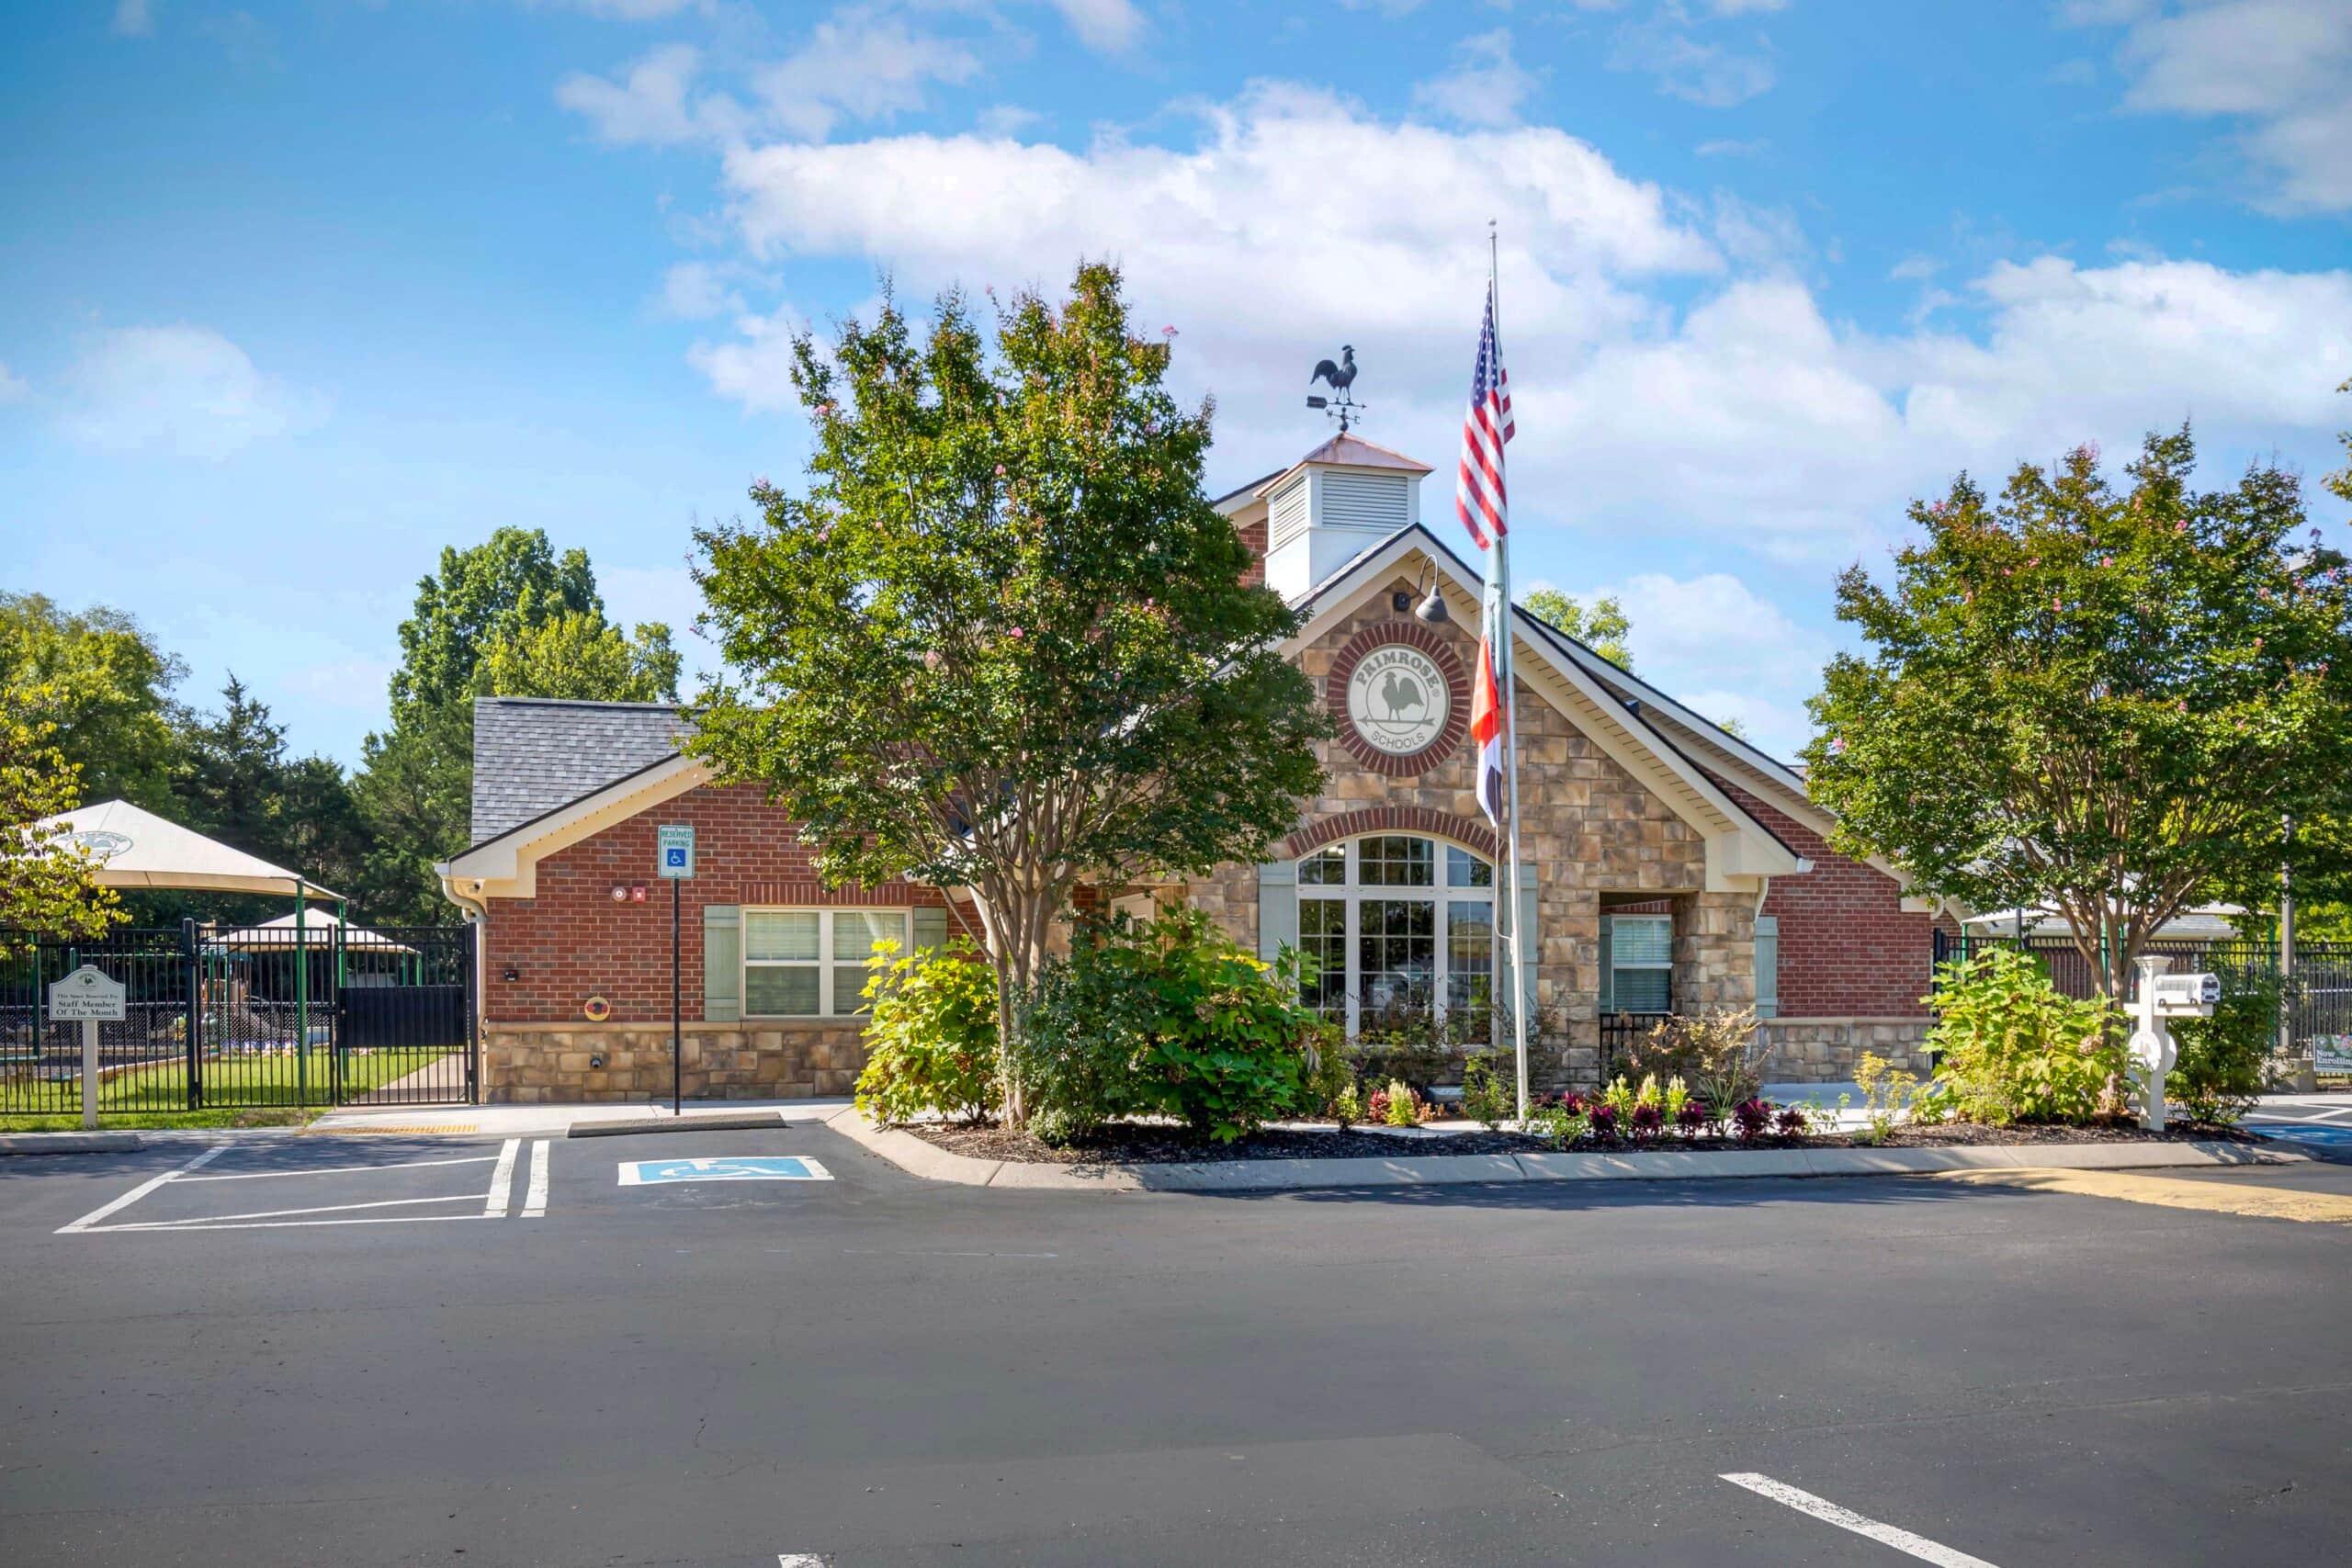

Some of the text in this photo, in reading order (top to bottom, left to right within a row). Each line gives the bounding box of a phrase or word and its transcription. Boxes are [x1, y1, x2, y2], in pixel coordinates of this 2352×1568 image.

[1355, 651, 1440, 688] PRIMROSE
[1371, 730, 1425, 750] SCHOOLS
[2316, 1049, 2335, 1057] Now
[2317, 1056, 2352, 1066] Enrollin
